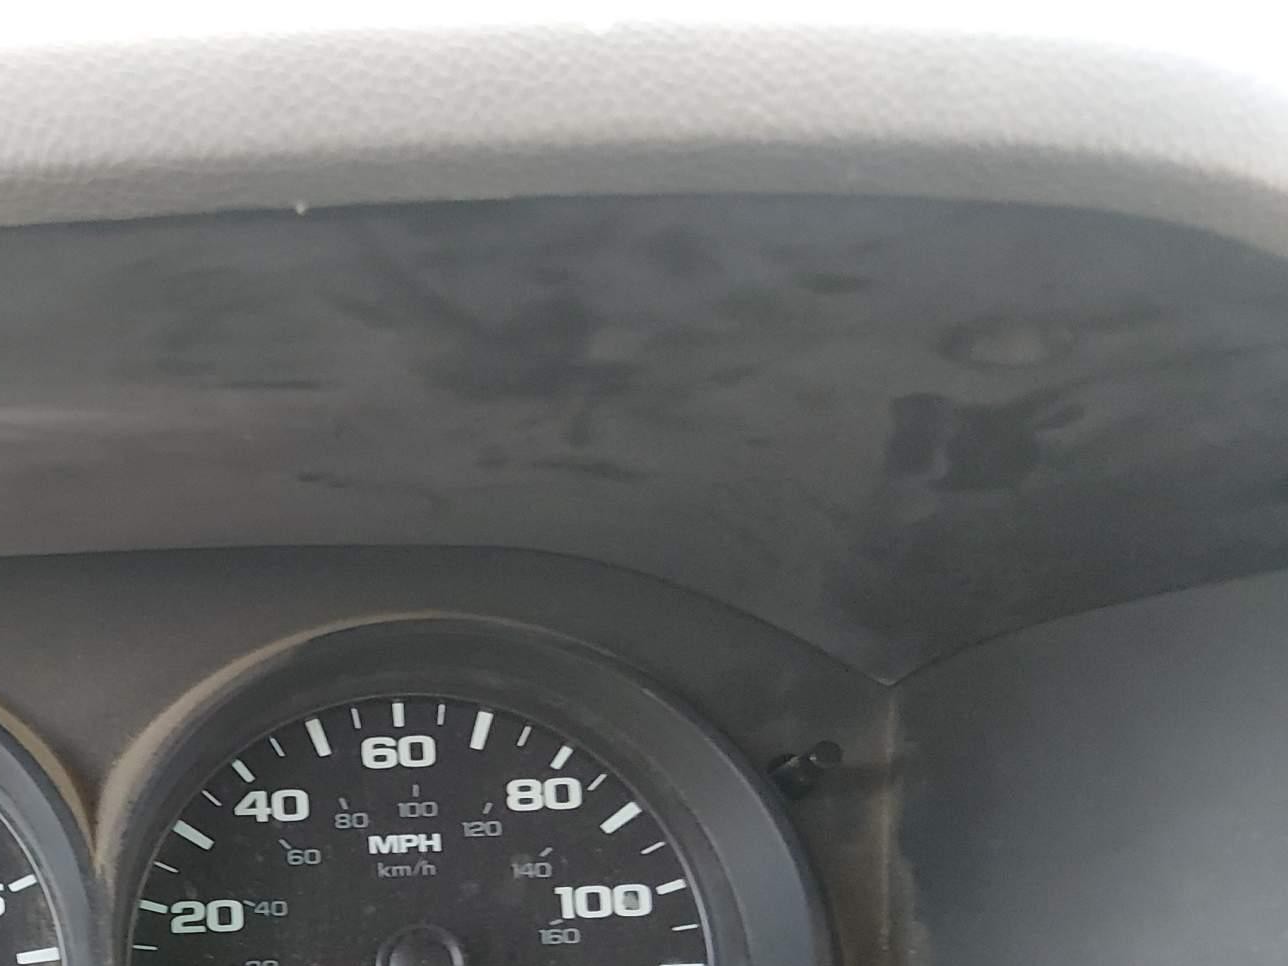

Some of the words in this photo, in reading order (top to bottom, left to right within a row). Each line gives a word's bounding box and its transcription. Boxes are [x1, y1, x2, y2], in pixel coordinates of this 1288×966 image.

[360, 735, 437, 769] 60
[505, 777, 583, 812] 80
[233, 788, 310, 823] 40
[397, 802, 438, 819] 100
[334, 813, 369, 831] 80
[461, 820, 503, 838] 120
[368, 833, 442, 855] MPH
[286, 848, 322, 867] 60
[377, 860, 437, 878] km/h
[512, 861, 553, 880] 140
[252, 900, 289, 917] 40
[554, 883, 653, 919] 100
[169, 898, 245, 934] 20
[538, 927, 581, 945] 160
